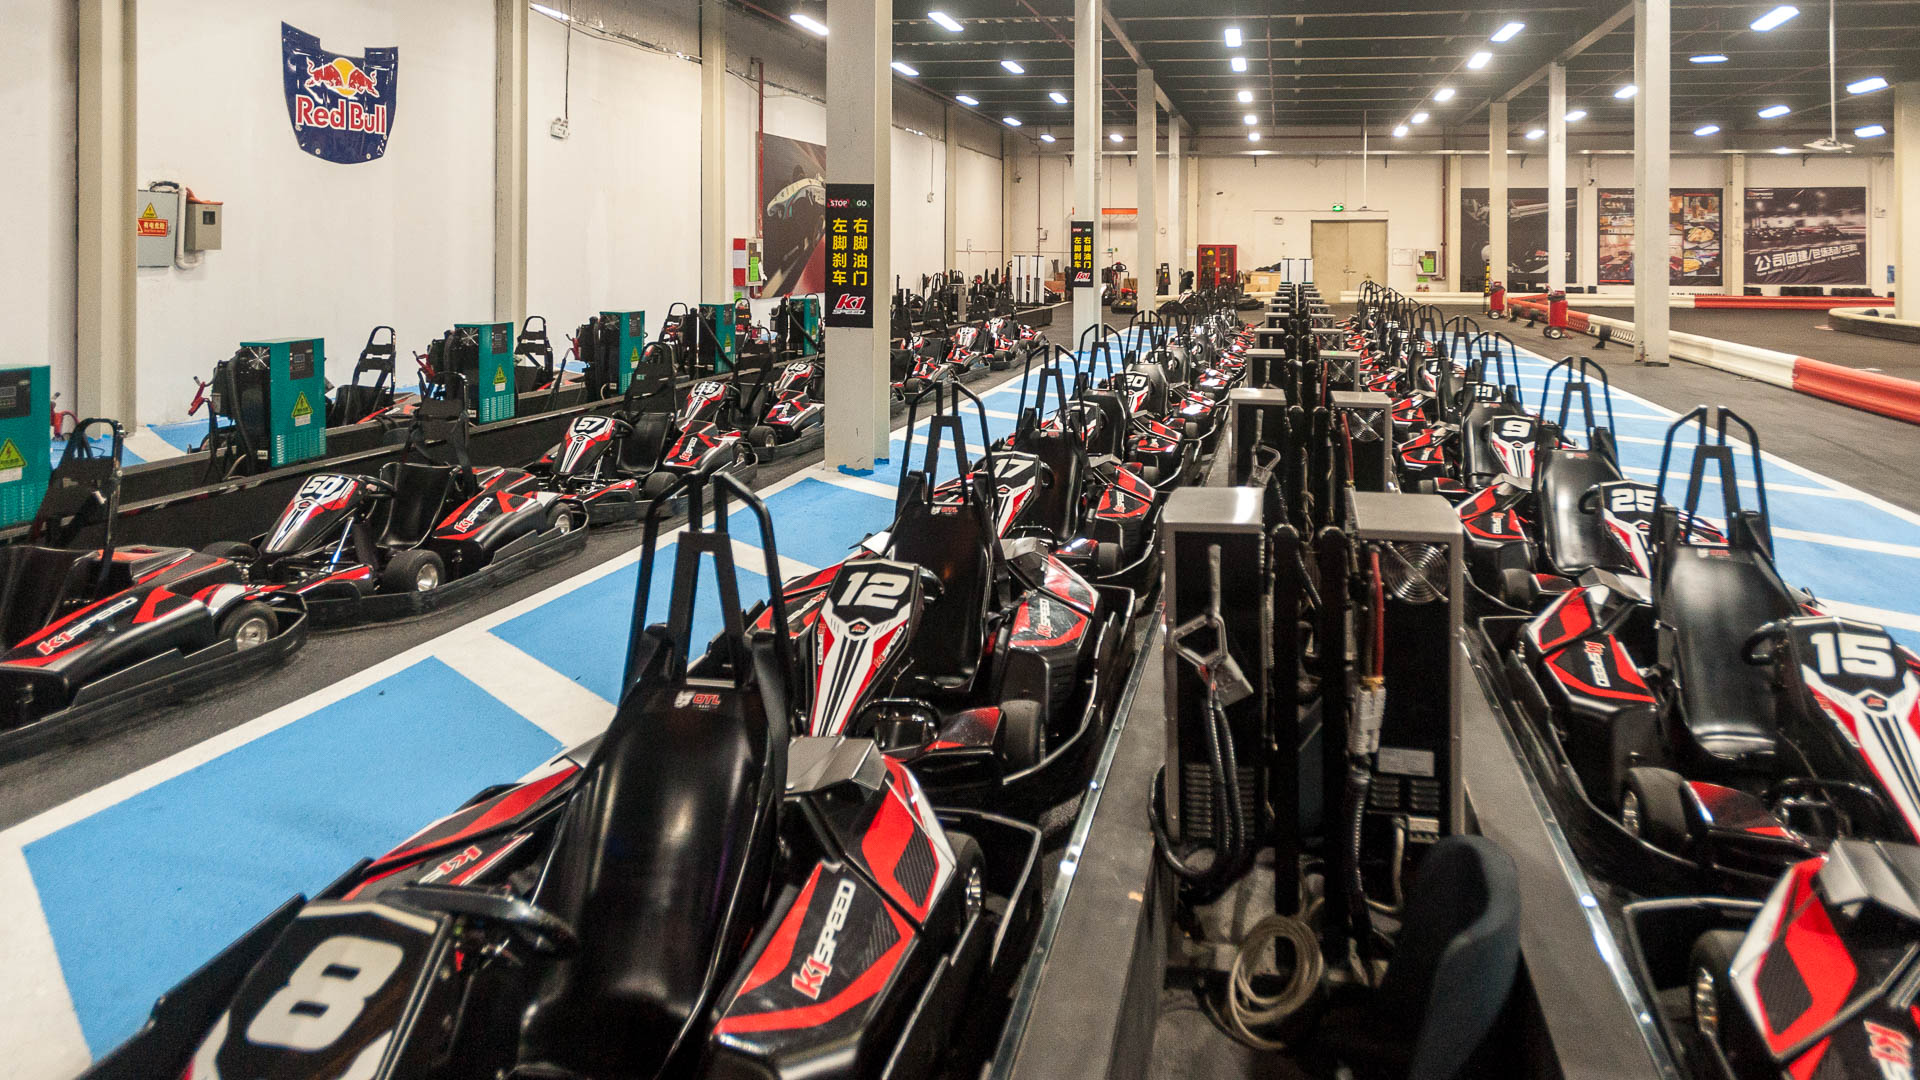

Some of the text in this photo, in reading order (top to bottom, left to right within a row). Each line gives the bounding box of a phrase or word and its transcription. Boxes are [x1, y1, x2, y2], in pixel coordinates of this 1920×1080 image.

[296, 94, 387, 135] Red Bull
[832, 217, 848, 286] 左脚刹车
[853, 217, 868, 286] 右脚油门
[835, 293, 866, 310] K1
[575, 416, 607, 431] 57
[1501, 420, 1531, 438] 9
[994, 458, 1034, 478] 17
[301, 475, 346, 495] 50
[1611, 486, 1657, 512] 25
[837, 571, 910, 610] 12
[1810, 632, 1897, 679] 15
[245, 935, 404, 1052] 8
